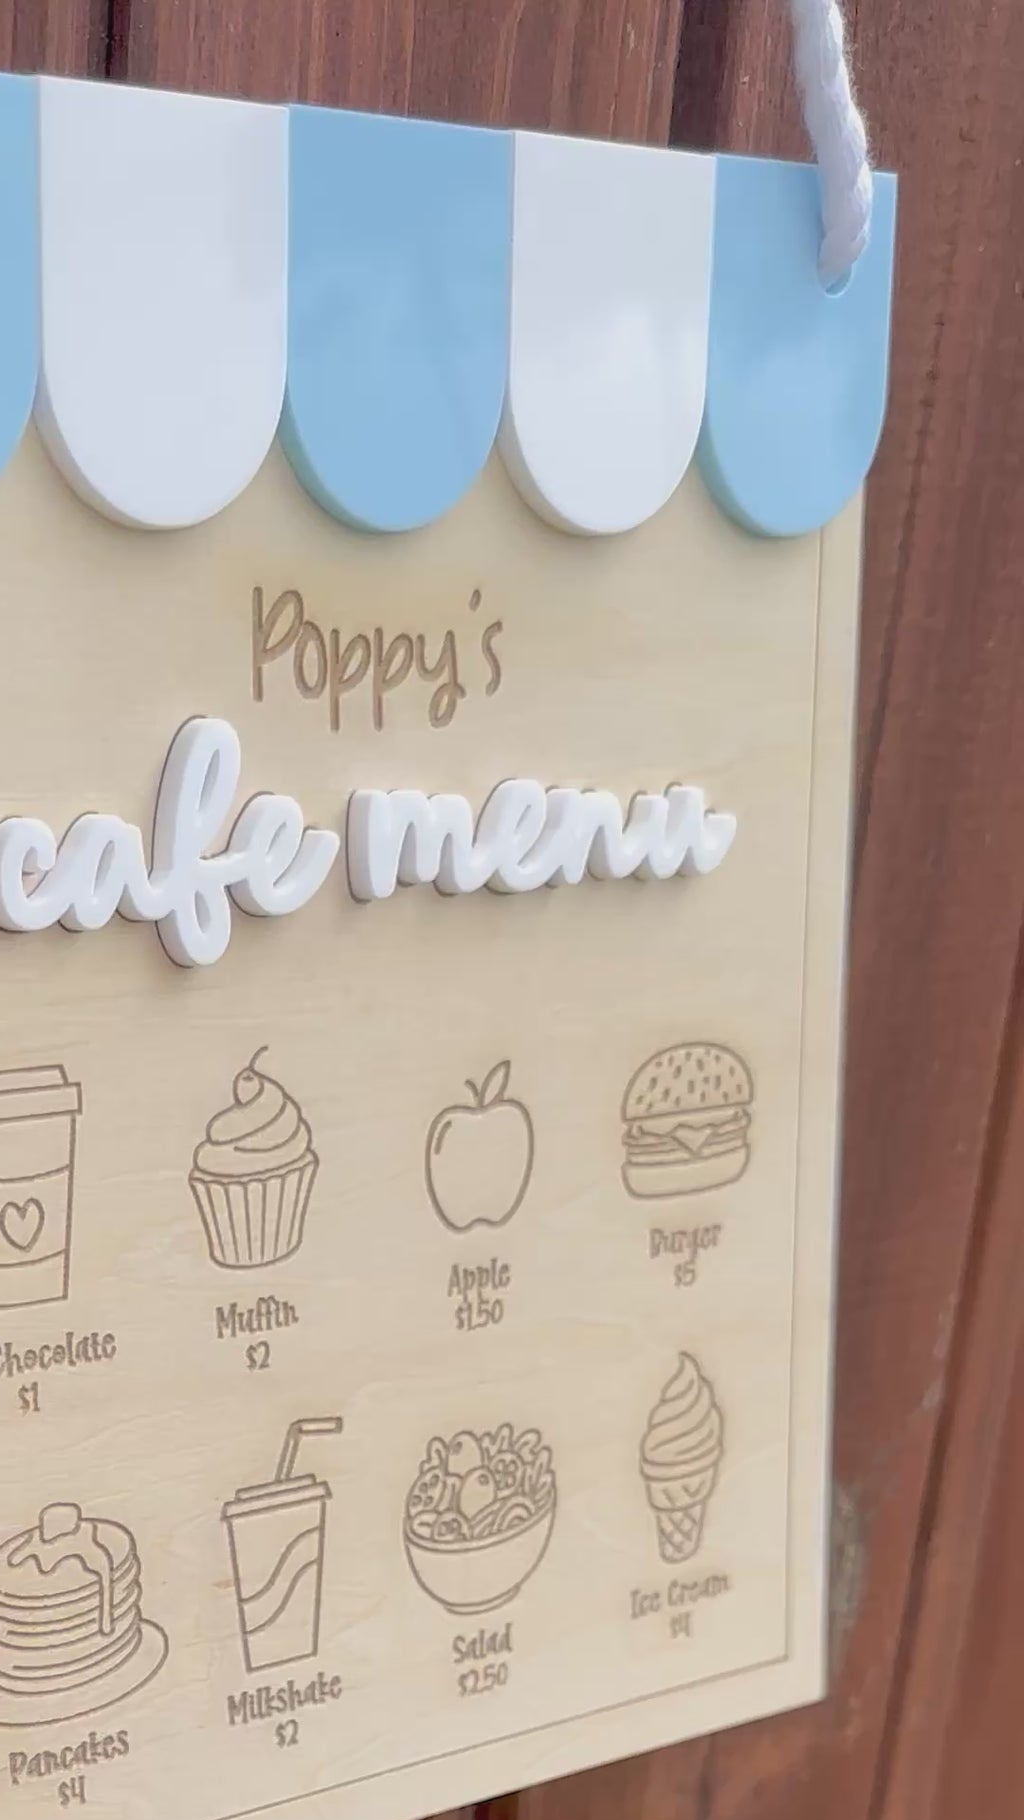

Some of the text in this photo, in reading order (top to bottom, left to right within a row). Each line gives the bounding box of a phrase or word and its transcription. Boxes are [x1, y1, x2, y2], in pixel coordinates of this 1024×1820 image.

[251, 586, 503, 731] Poppy's
[346, 778, 738, 902] menu
[649, 1224, 722, 1262] Burger
[447, 1257, 511, 1302] Apple
[673, 1261, 696, 1288] $5
[215, 1295, 299, 1339] Muffin
[245, 1340, 271, 1371] $2
[17, 1381, 40, 1416] $1
[630, 1574, 731, 1619] Ice Cream
[452, 1622, 513, 1664] Salad
[226, 1672, 344, 1726] Milkshake
[275, 1718, 300, 1749] $2
[8, 1729, 130, 1785] Pancakes
[57, 1775, 87, 1807] $4
